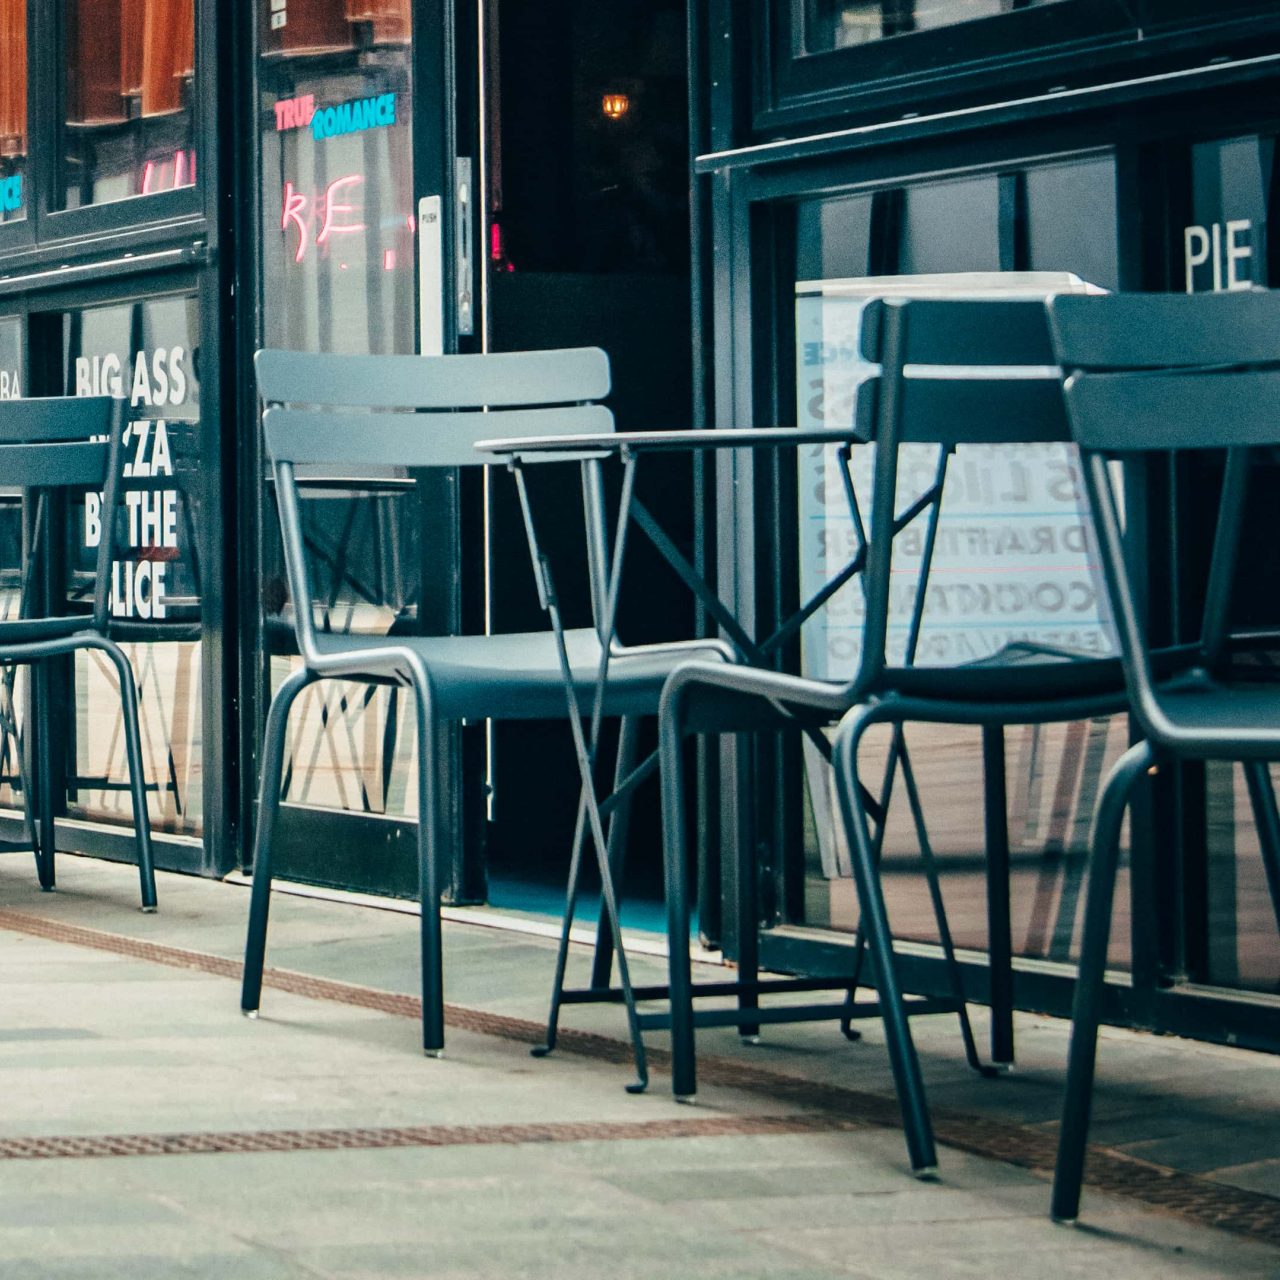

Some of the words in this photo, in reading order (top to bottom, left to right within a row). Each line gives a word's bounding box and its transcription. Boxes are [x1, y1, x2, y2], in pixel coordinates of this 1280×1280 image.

[274, 94, 314, 131] TRUE
[310, 92, 396, 141] ROMANCE
[1184, 219, 1252, 295] PIE
[76, 353, 122, 399] BIG
[131, 346, 186, 407] ASS
[126, 490, 177, 547] THE
[108, 560, 166, 619] LICE
